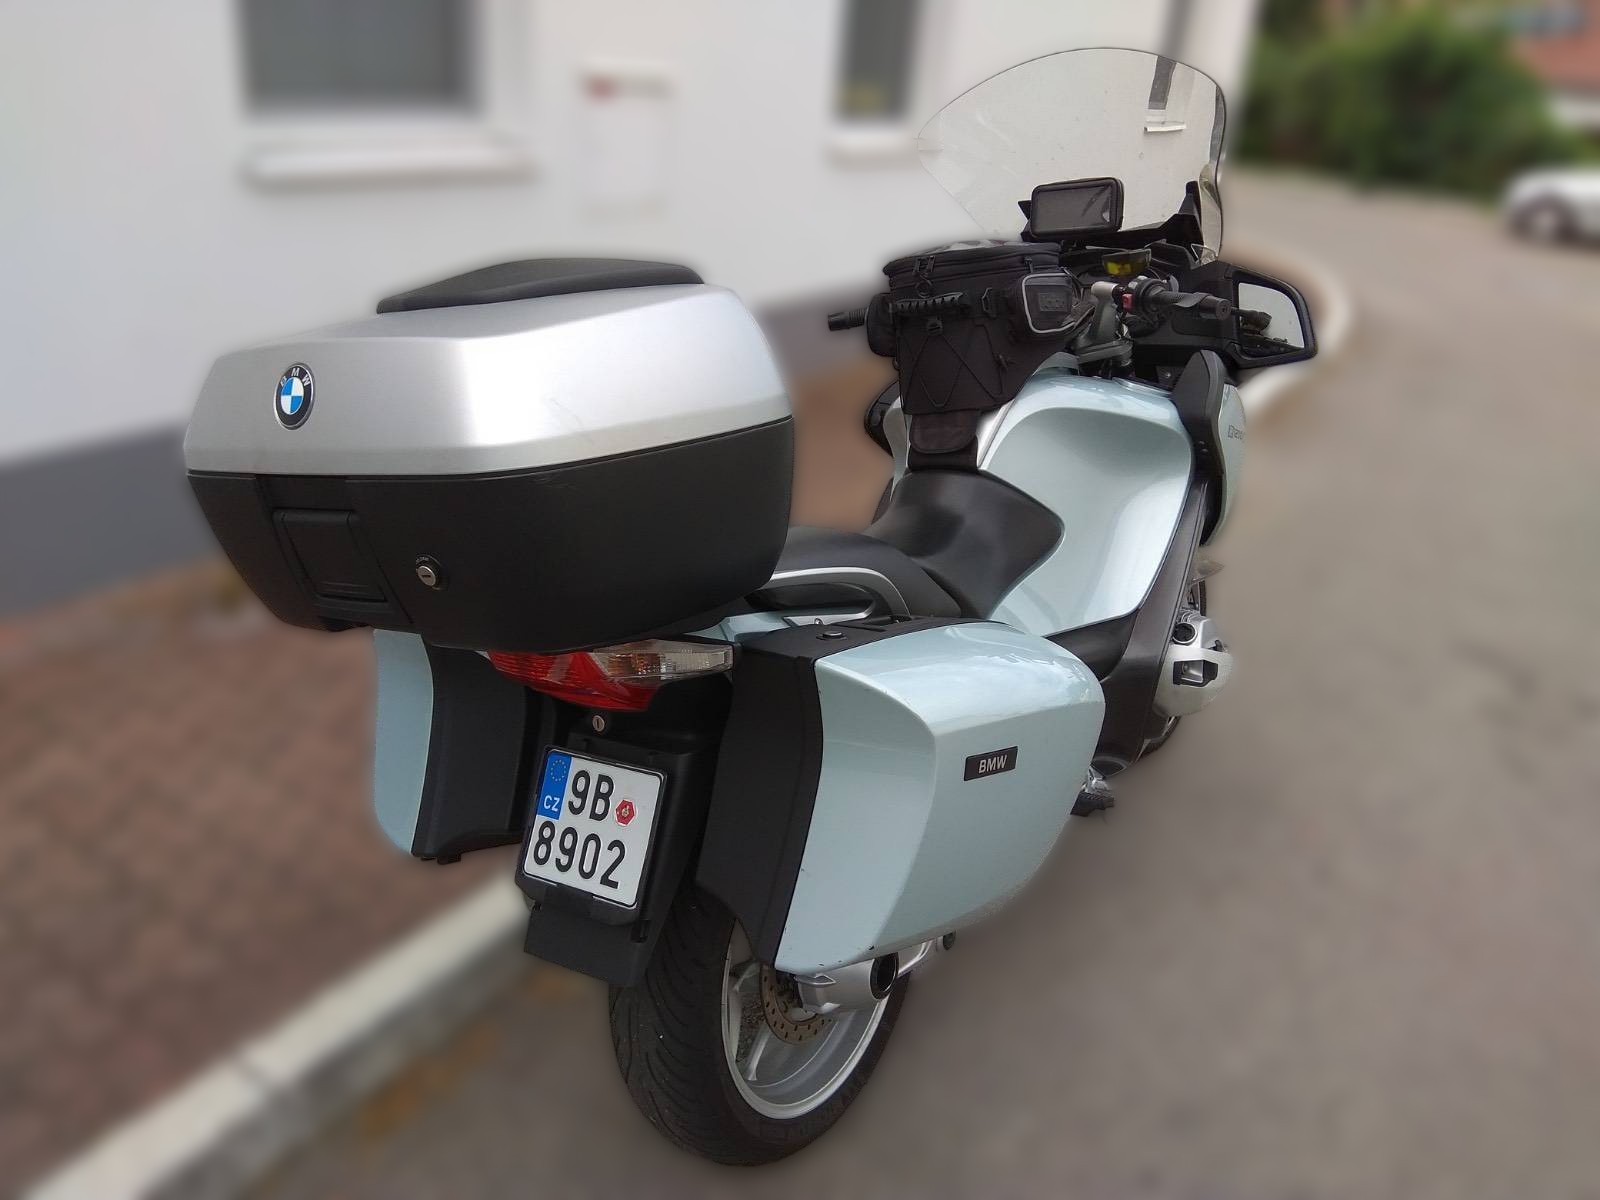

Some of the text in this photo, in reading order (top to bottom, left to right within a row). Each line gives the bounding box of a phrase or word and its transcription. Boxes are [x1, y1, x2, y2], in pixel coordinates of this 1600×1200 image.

[280, 367, 311, 387] BMW
[978, 754, 1008, 774] BMW
[543, 795, 560, 812] CZ
[568, 770, 614, 821] 9B
[533, 820, 626, 889] 8902
